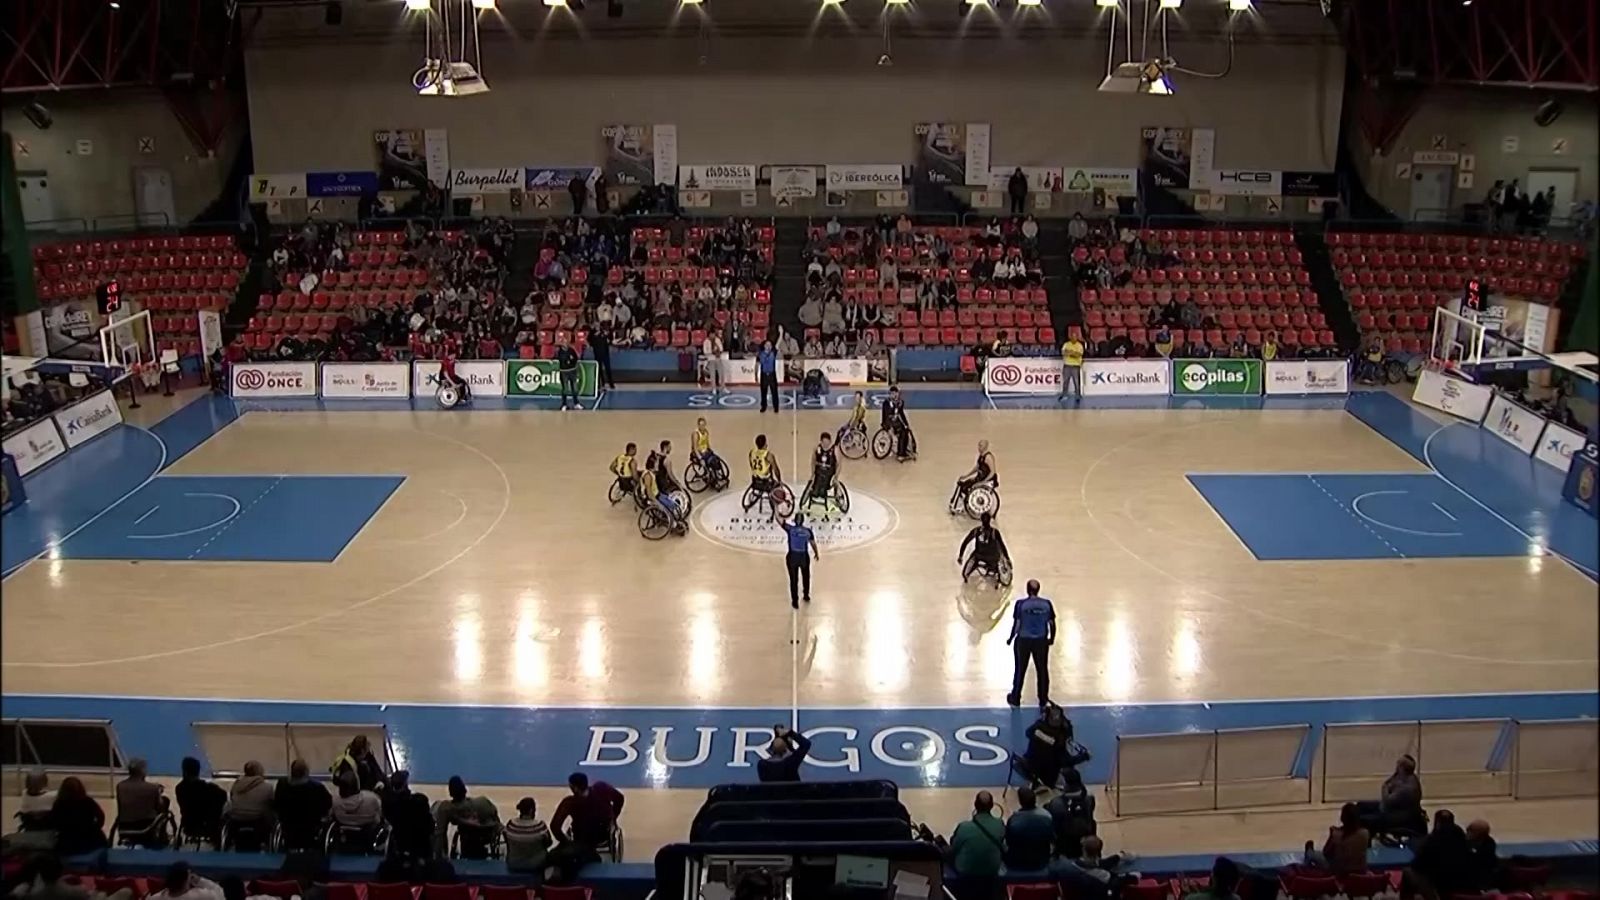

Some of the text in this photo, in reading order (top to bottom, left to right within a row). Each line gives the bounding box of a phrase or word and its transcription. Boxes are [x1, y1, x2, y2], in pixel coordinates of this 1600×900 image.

[455, 169, 518, 189] Burpellet
[845, 172, 899, 182] IBEREÓLICA
[106, 295, 119, 313] 24
[267, 378, 303, 388] ONCE
[1024, 375, 1061, 385] ONCE
[1106, 372, 1161, 384] CaixaBank
[1183, 369, 1245, 386] ecopilas
[578, 724, 1011, 772] BURGOS
